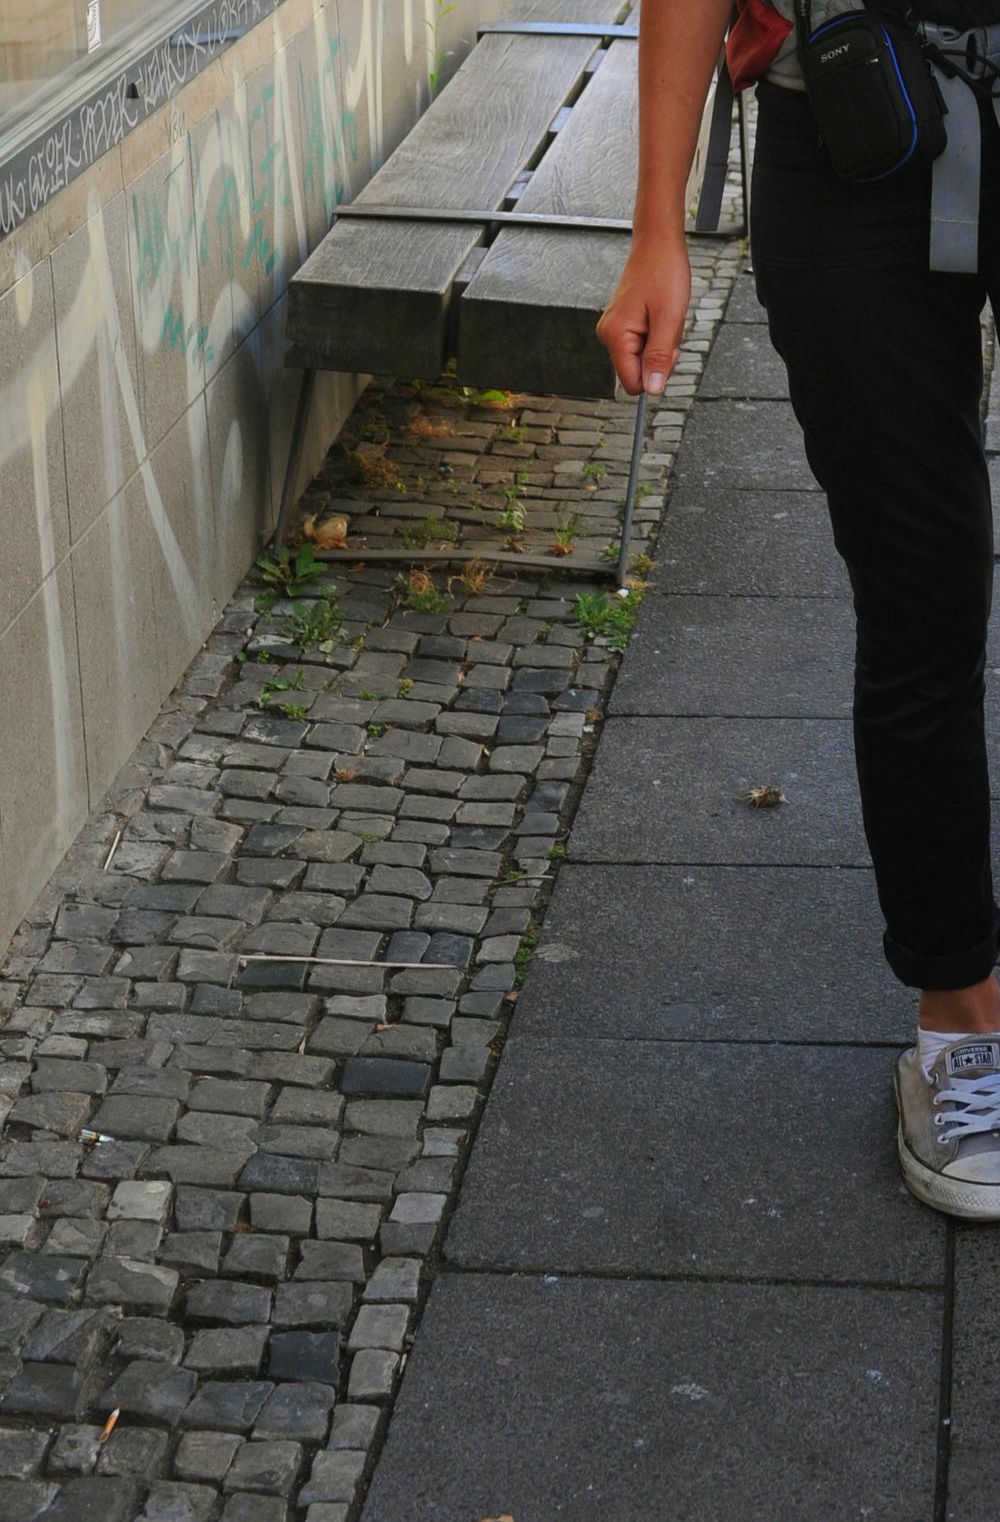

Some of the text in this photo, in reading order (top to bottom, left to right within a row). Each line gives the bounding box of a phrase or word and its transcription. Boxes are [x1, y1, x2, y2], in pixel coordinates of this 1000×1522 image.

[820, 43, 850, 63] SONY
[952, 1052, 993, 1070] ALL STAR
